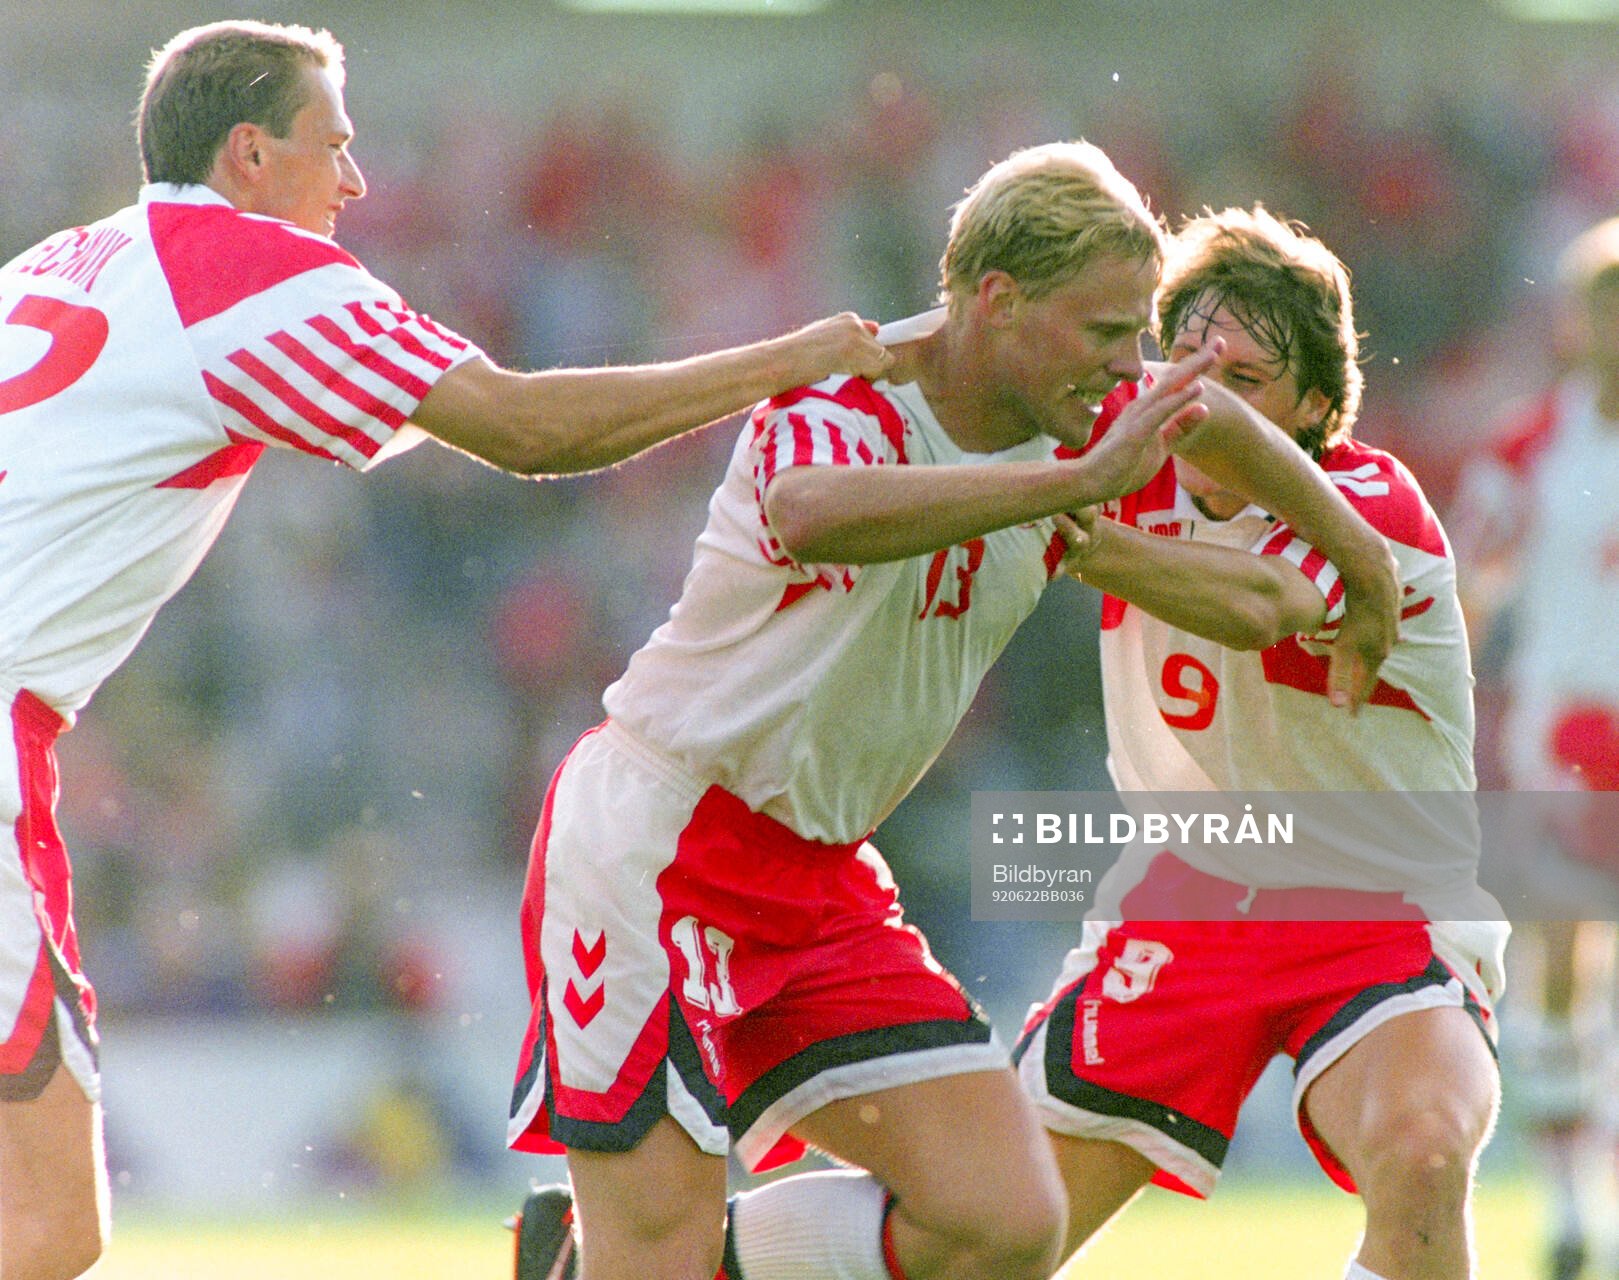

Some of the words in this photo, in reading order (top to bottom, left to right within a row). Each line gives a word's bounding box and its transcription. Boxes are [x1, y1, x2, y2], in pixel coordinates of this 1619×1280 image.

[918, 537, 985, 621] 13
[1160, 653, 1219, 731] 9
[1102, 938, 1175, 1003] 9
